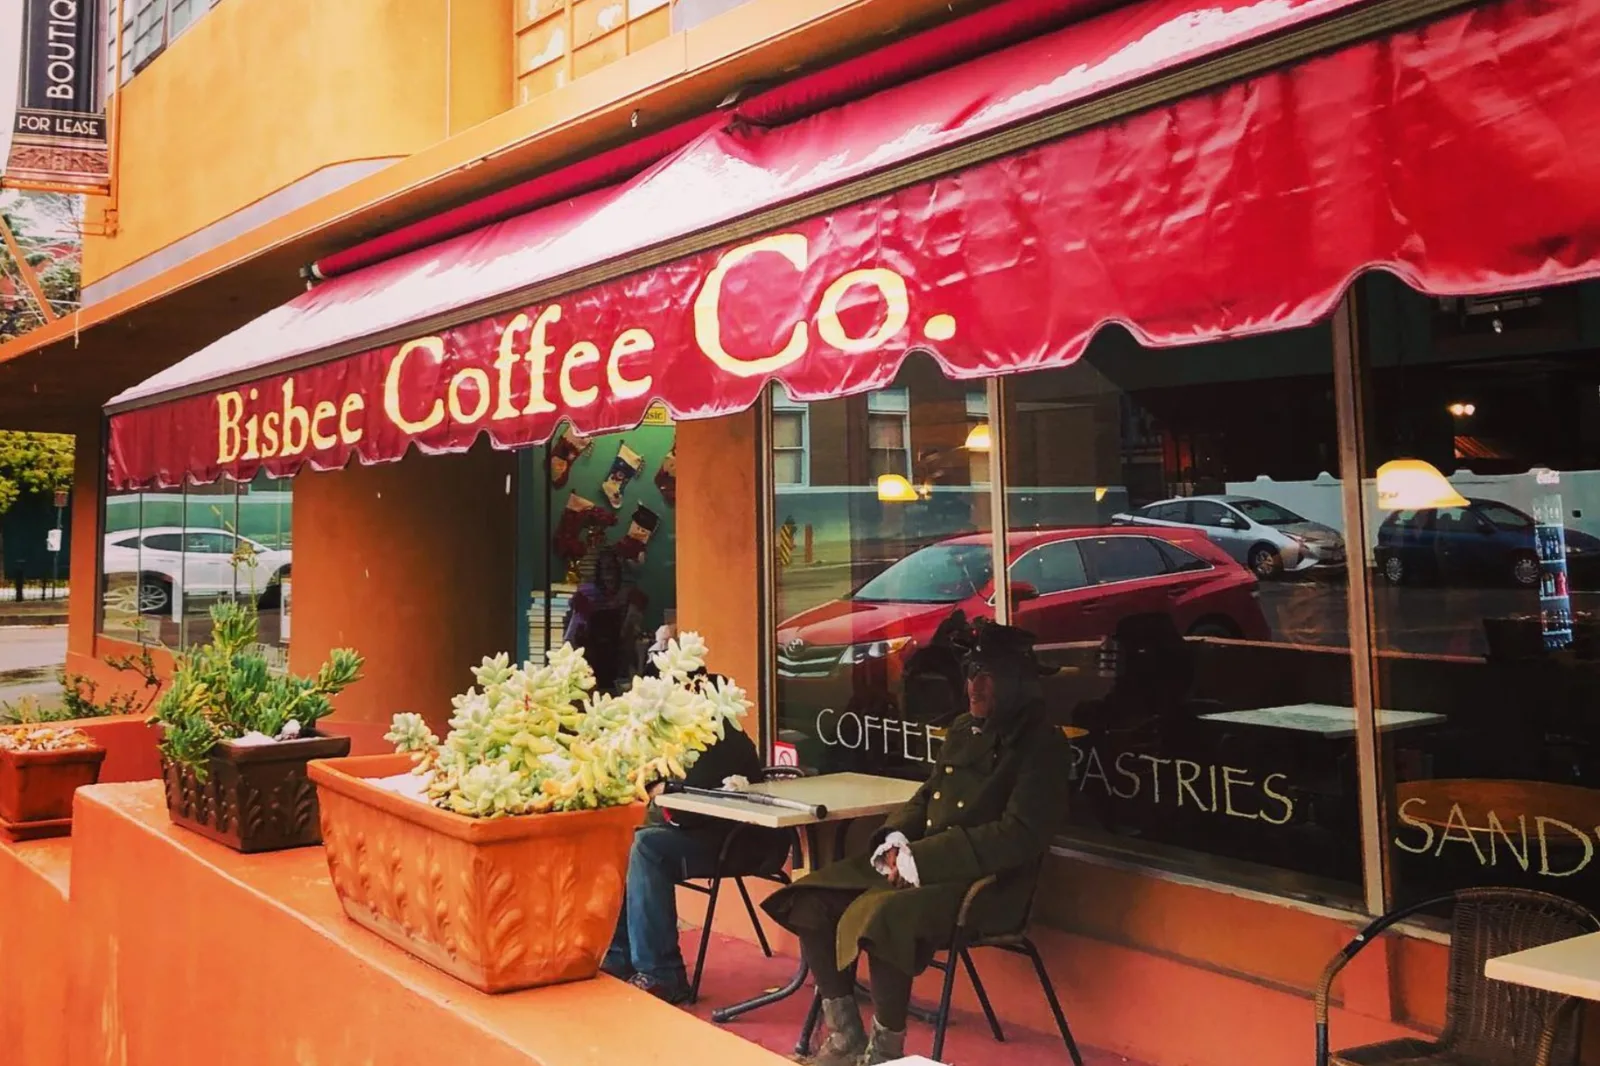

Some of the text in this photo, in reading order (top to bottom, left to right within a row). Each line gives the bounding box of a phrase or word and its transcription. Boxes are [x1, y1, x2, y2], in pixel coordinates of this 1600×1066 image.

[46, 0, 77, 99] BOUTIQ
[18, 115, 99, 136] FOR LEASE
[215, 233, 957, 464] Bisbee Coffee Co.
[816, 708, 1294, 825] COFFEE PASTRIES
[1394, 797, 1600, 877] SAND
